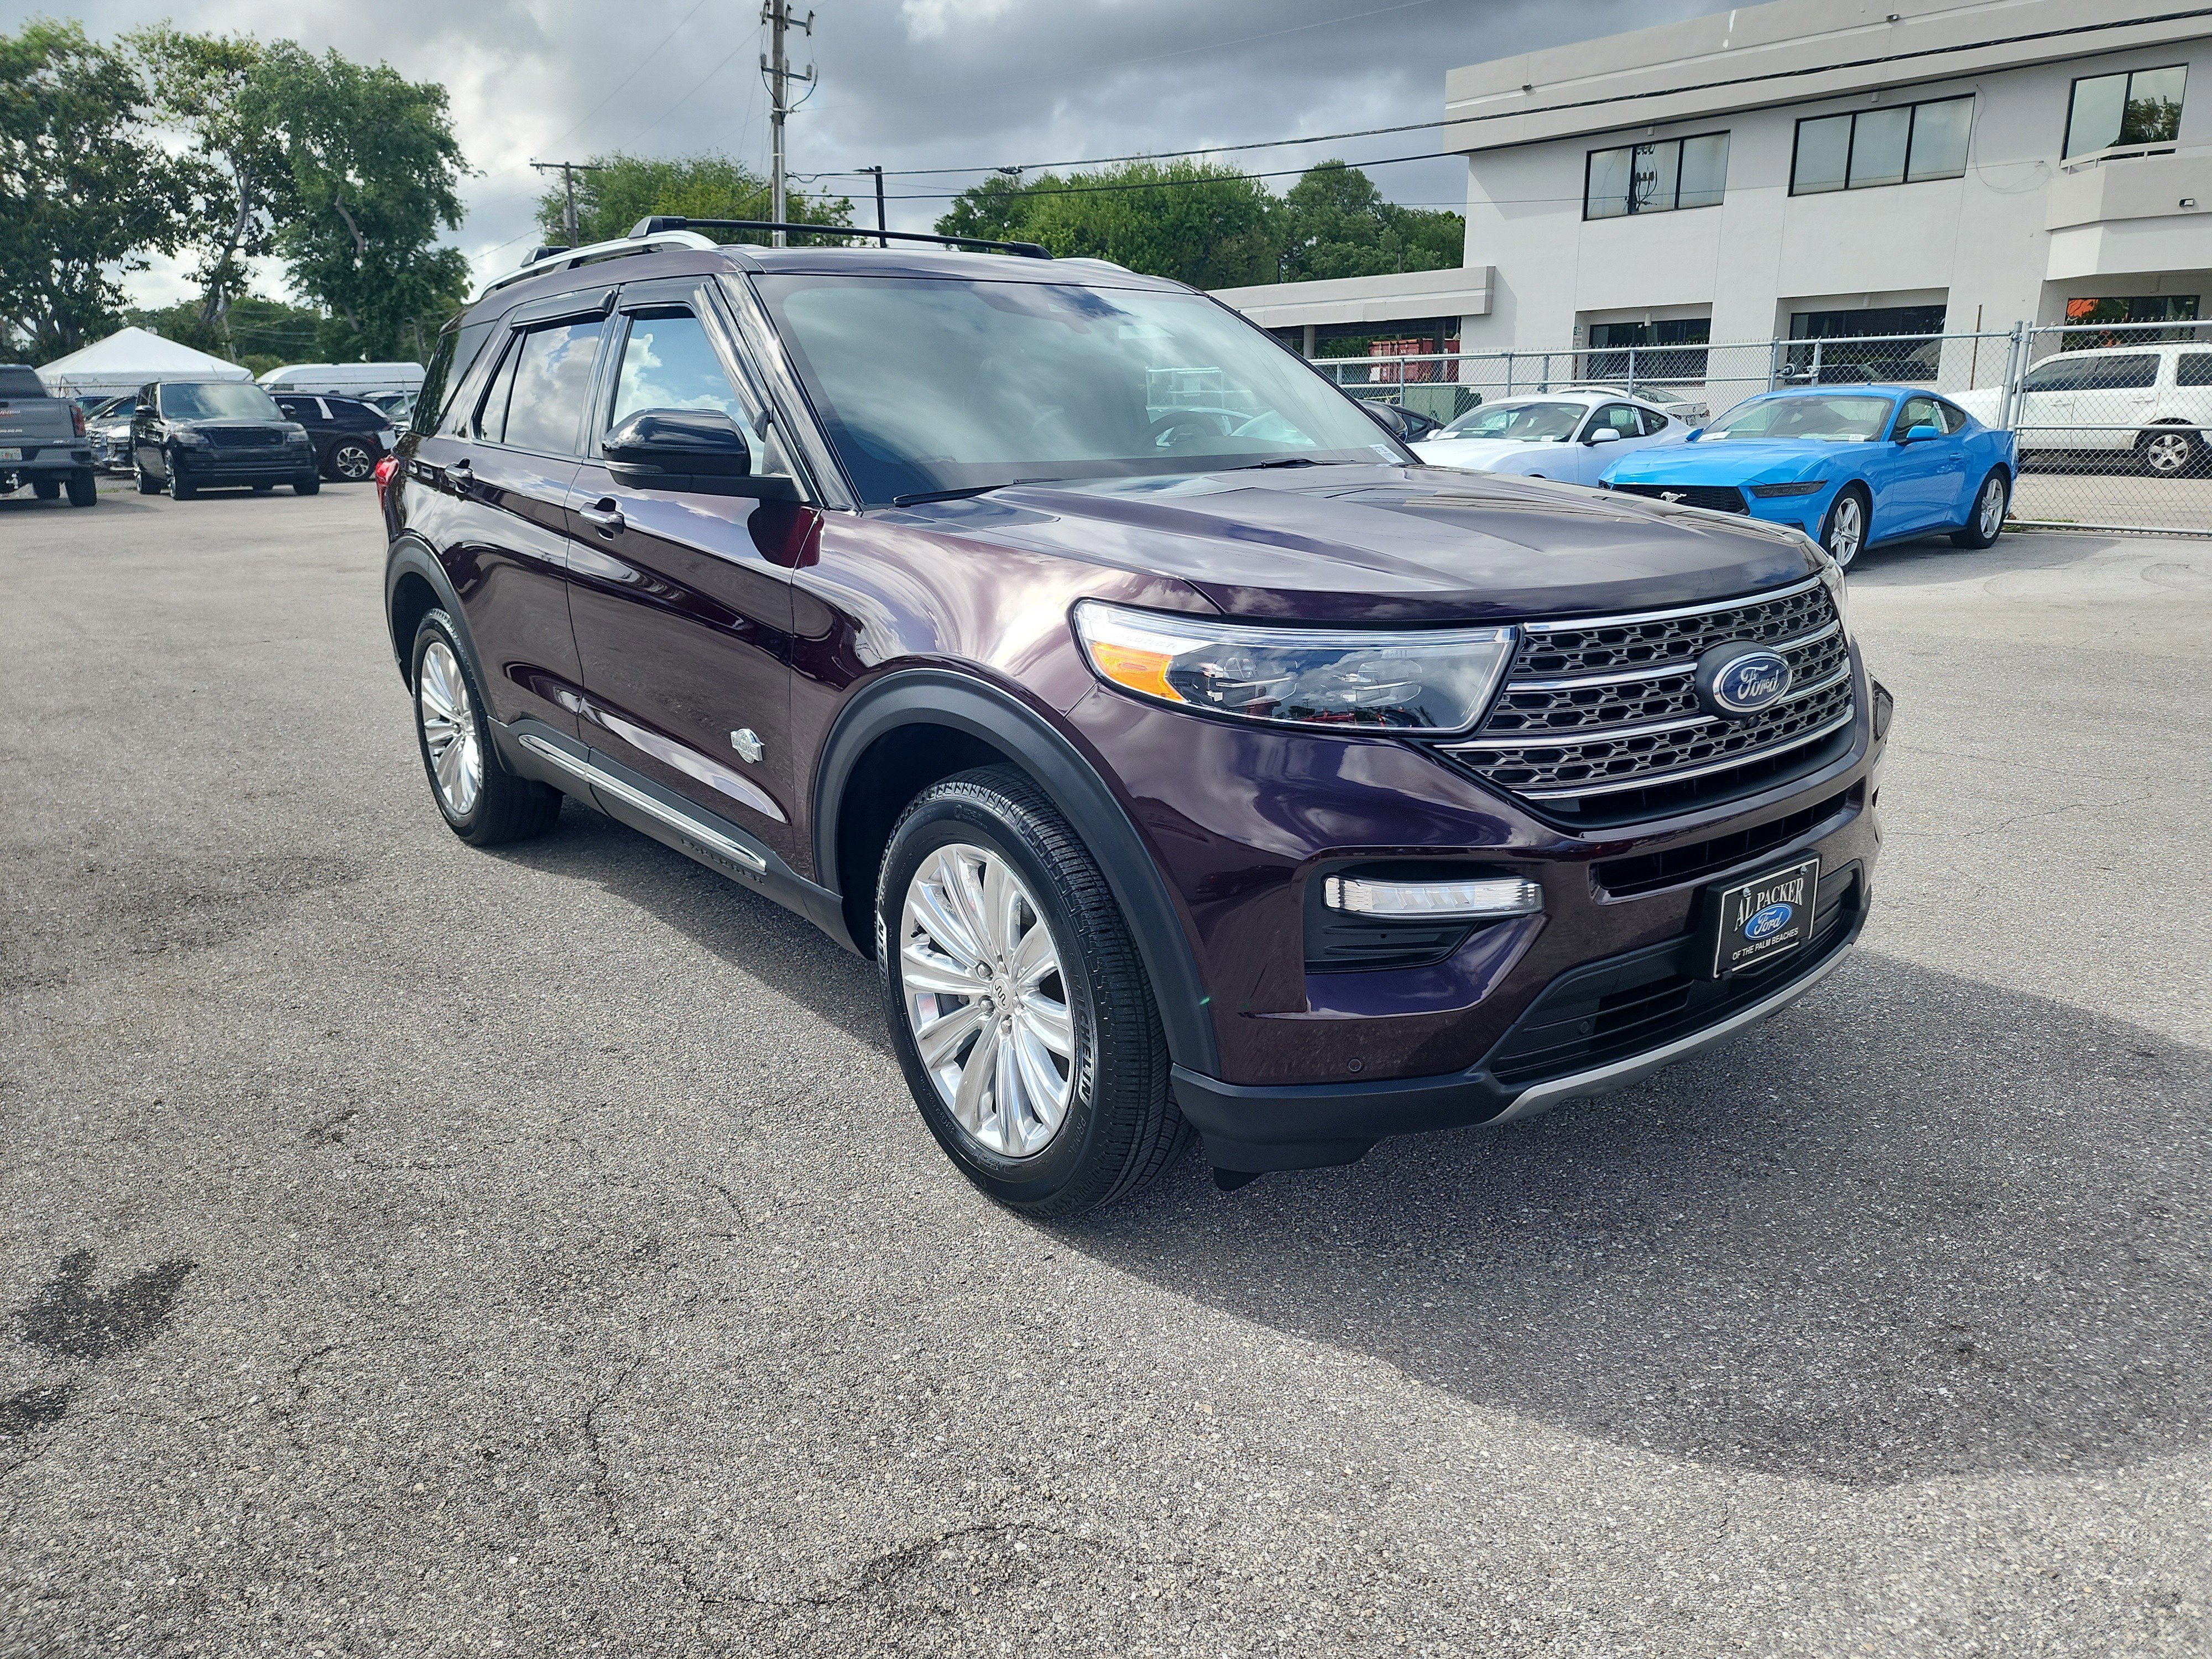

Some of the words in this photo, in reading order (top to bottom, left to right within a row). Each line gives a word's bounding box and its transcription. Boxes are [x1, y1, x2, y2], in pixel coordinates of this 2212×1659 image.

[1737, 665, 1779, 700] Ford
[1734, 895, 1754, 932] AL
[1755, 877, 1804, 912] PACKER
[1754, 909, 1782, 935] Ford
[1732, 948, 1741, 961] OF
[1741, 945, 1755, 958] THE
[1754, 938, 1772, 952] PALM
[1771, 927, 1799, 944] BEACHES
